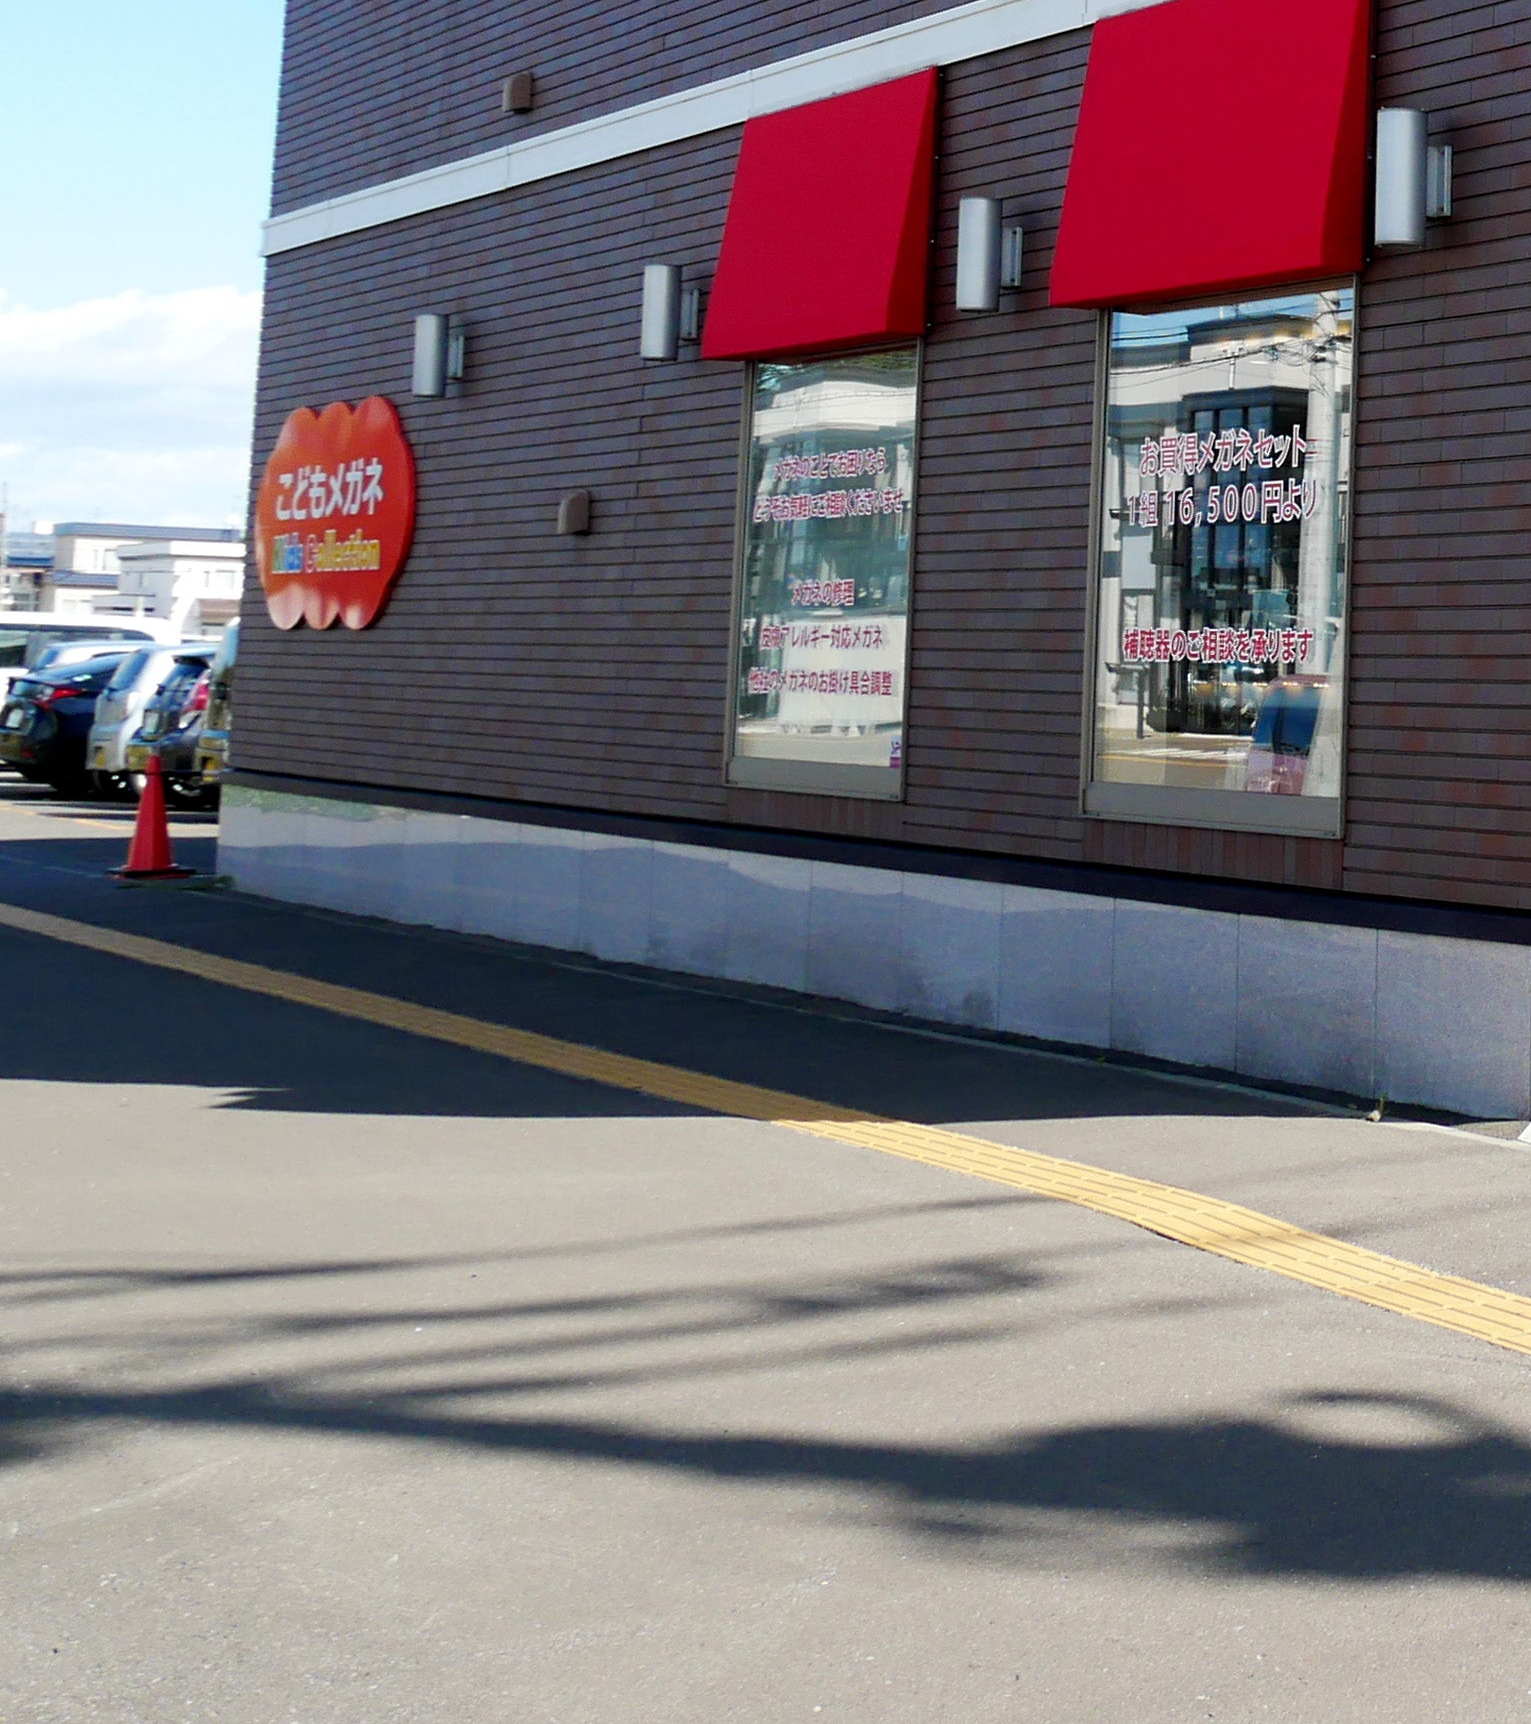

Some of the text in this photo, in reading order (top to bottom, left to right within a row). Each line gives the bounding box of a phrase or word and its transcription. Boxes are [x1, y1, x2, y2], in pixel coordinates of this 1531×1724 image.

[1139, 424, 1308, 478] お買得メガネセット
[275, 457, 384, 521] こどもメガネ
[790, 578, 855, 607] メガネの修理
[1122, 626, 1314, 663] 補聴器のご相談を承ります
